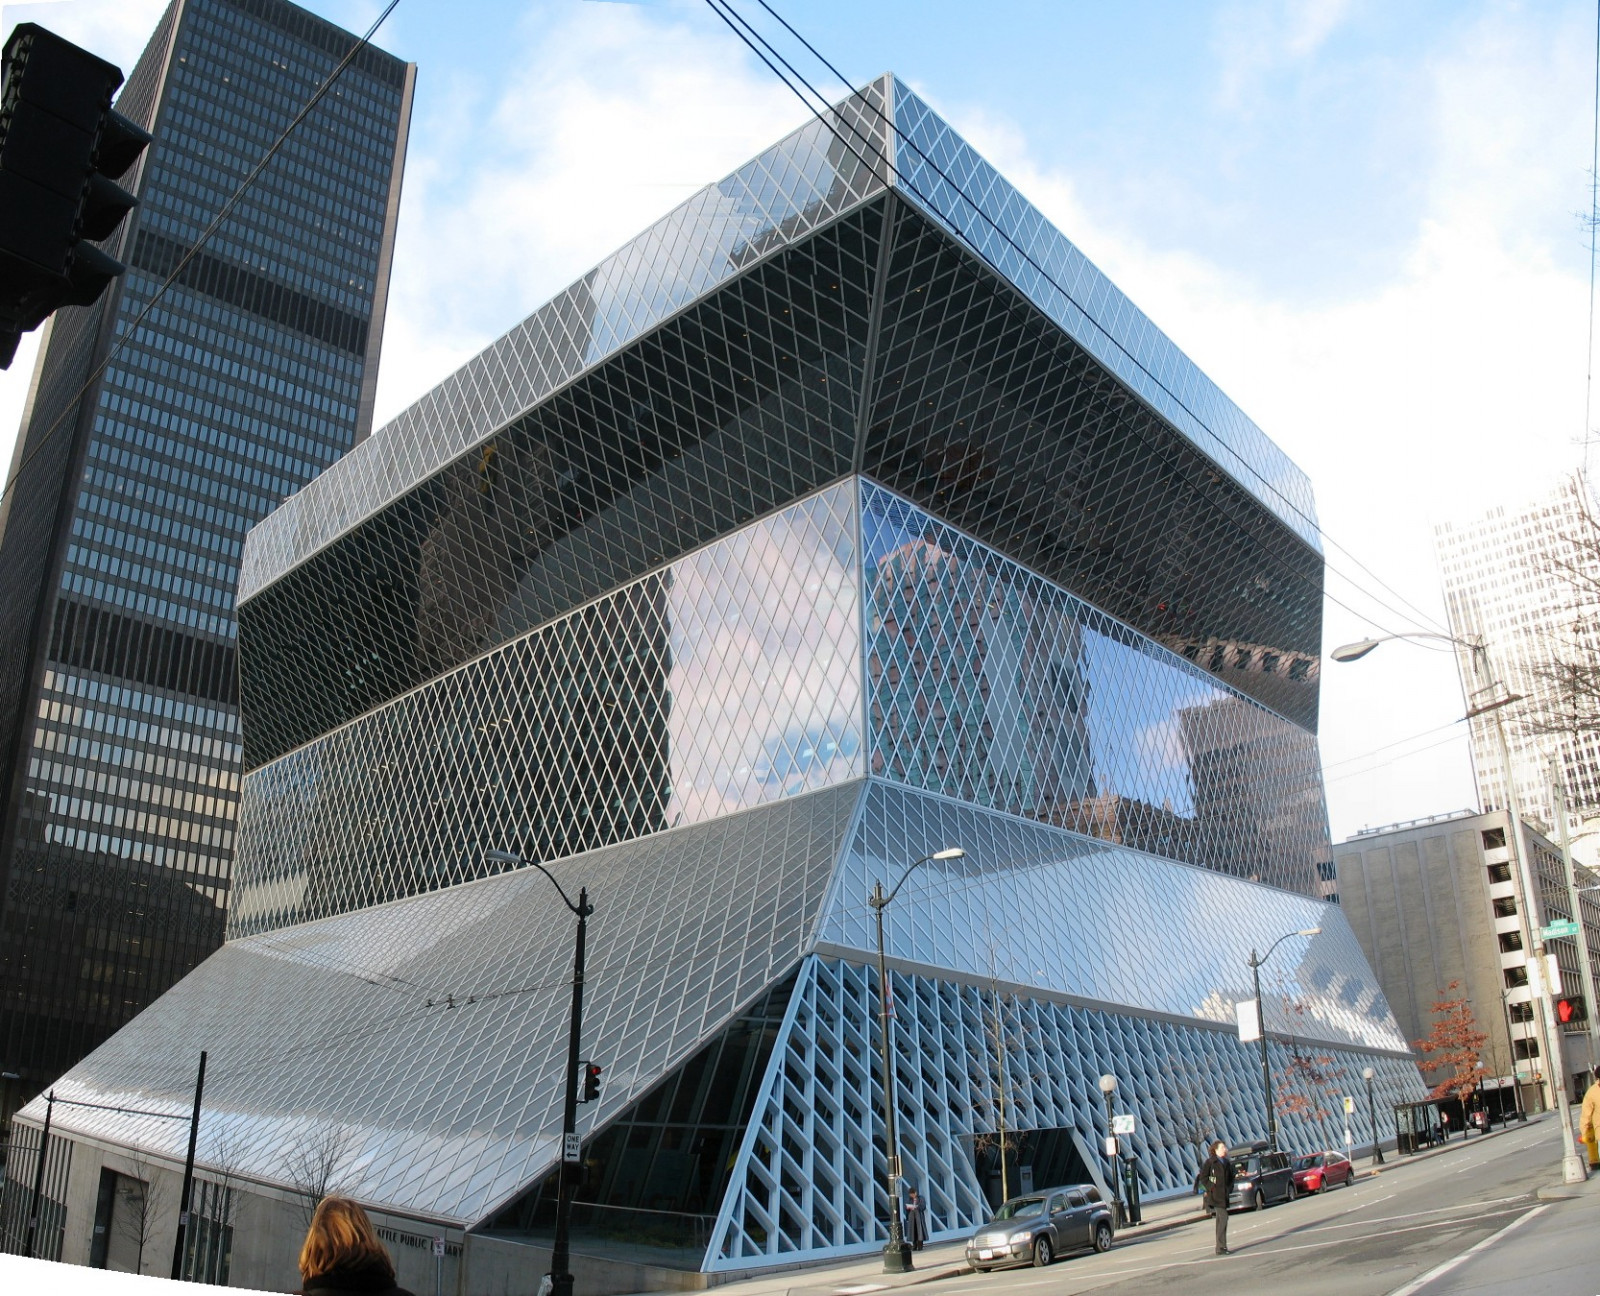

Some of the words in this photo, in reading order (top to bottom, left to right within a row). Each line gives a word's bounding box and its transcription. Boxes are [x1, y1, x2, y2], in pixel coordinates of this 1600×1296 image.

[375, 1228, 398, 1243] ATTLE
[400, 1233, 427, 1250] PUBLIC
[430, 1240, 463, 1258] LARY
